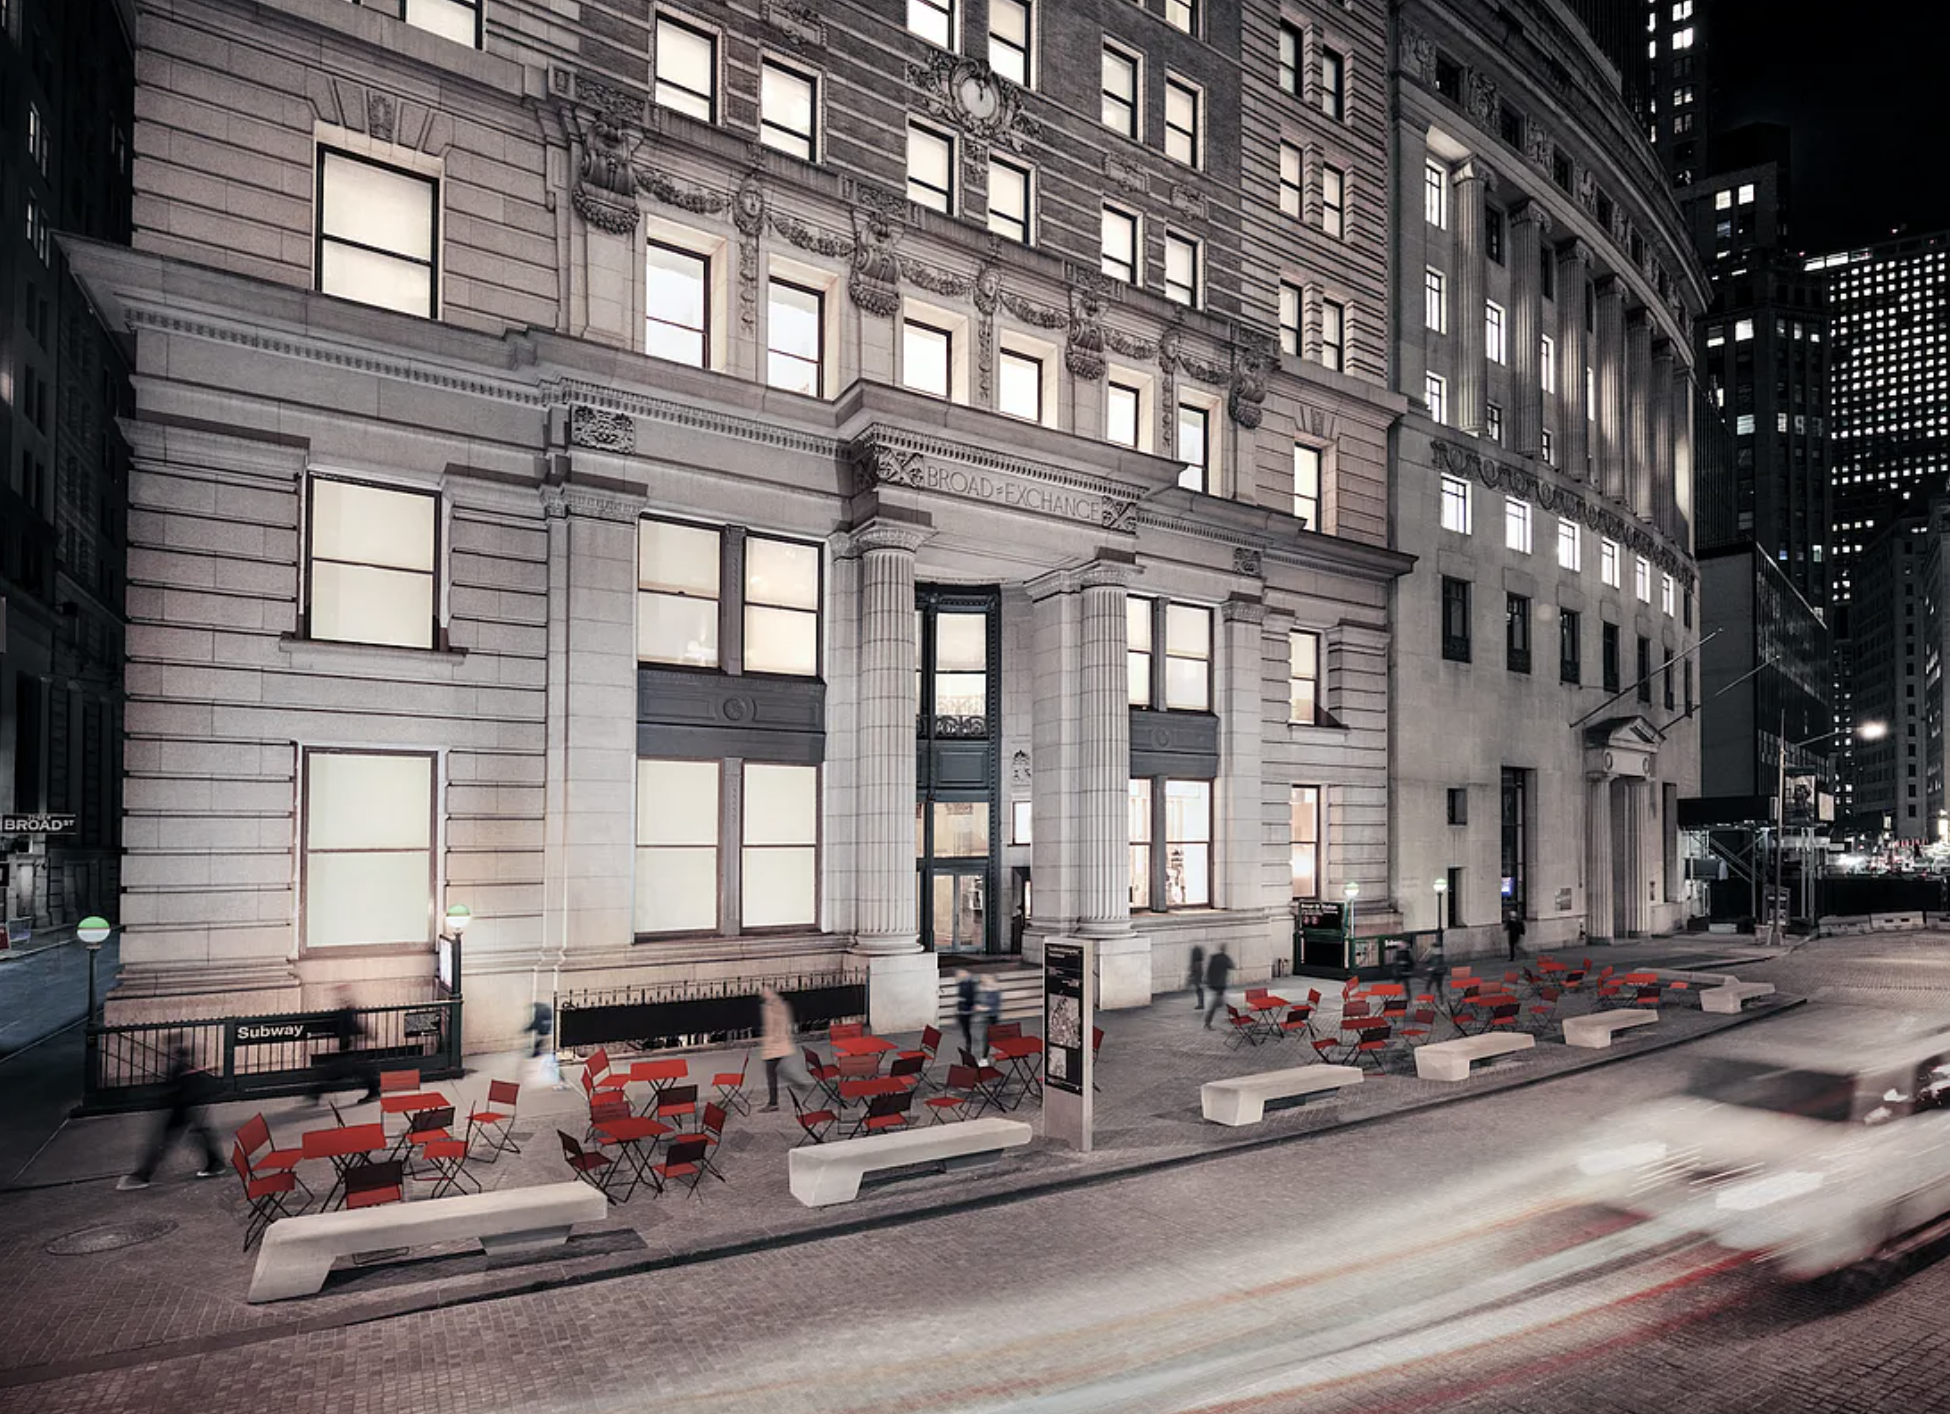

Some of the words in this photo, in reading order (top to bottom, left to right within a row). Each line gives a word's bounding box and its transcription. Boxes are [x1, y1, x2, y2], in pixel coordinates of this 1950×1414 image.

[926, 466, 993, 498] BROAD
[1004, 483, 1101, 522] EXCHANGE
[4, 819, 63, 831] BROAD
[237, 1025, 304, 1039] Subway
